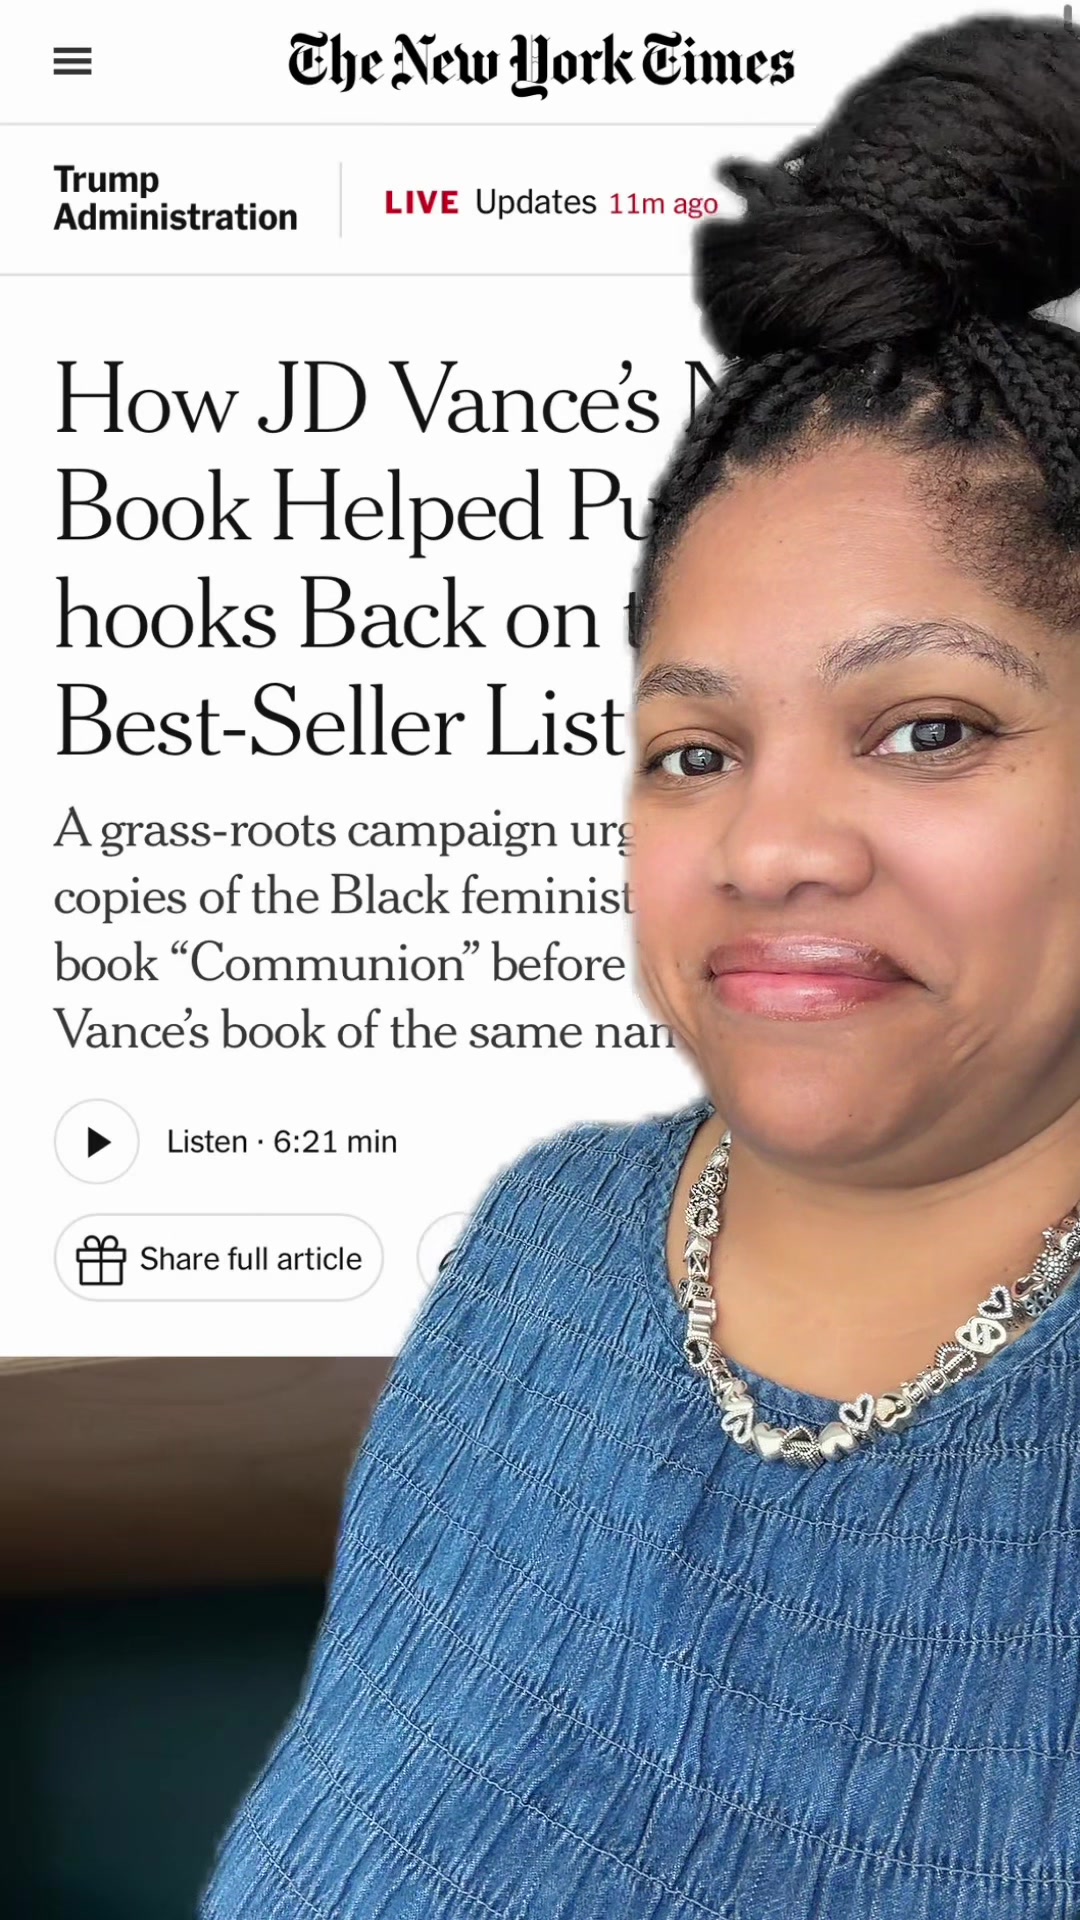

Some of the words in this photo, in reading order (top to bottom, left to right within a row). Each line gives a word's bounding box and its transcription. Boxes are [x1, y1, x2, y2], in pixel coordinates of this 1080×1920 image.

[288, 31, 384, 92] The
[391, 33, 500, 90] New
[509, 33, 636, 101] York
[642, 31, 795, 86] Times
[53, 165, 159, 198] Trump
[386, 190, 459, 214] LIVE
[477, 188, 597, 220] Updates
[610, 193, 664, 214] 11m
[674, 198, 719, 220] ago
[54, 203, 297, 231] Administration
[57, 361, 239, 433] How
[258, 361, 366, 433] JD
[388, 360, 660, 433] Vance’s
[57, 468, 252, 541] Book
[273, 468, 544, 559] Helped
[56, 576, 276, 648] hooks
[300, 576, 486, 648] Back
[507, 604, 600, 648] on
[57, 682, 465, 756] Best-Seller
[487, 683, 626, 756] List
[53, 806, 92, 846] A
[101, 815, 336, 857] grass-roots
[348, 809, 557, 857] campaign
[55, 877, 187, 923] copies
[200, 874, 243, 914] of
[252, 874, 319, 914] the
[331, 873, 450, 914] Black
[462, 874, 636, 914] feminist
[54, 941, 159, 981] book
[171, 940, 479, 981] “Communion”
[491, 940, 626, 981] before
[53, 1007, 209, 1048] Vance’s
[221, 1008, 326, 1048] book
[338, 1008, 381, 1048] of
[390, 1008, 457, 1048] the
[469, 1024, 582, 1048] same
[169, 1129, 247, 1153] Listen
[274, 1130, 337, 1153] 6:21
[348, 1129, 396, 1153] min
[141, 1246, 219, 1270] Share
[227, 1246, 267, 1270] full
[277, 1246, 362, 1270] article
